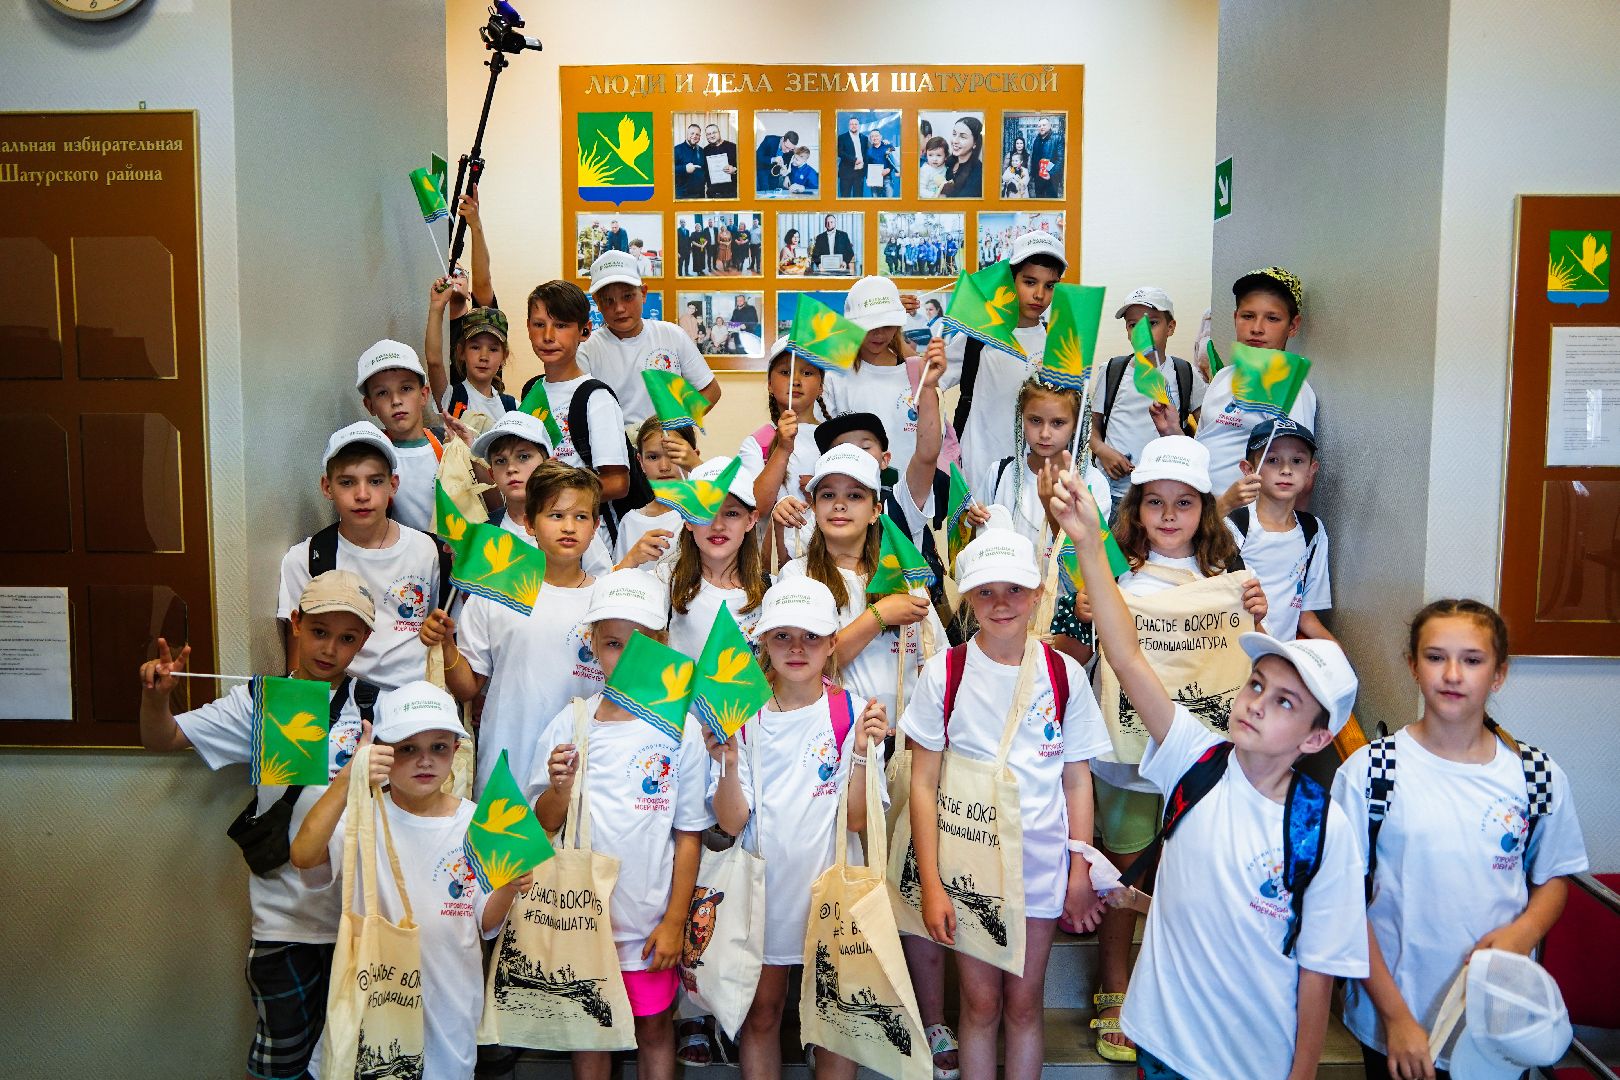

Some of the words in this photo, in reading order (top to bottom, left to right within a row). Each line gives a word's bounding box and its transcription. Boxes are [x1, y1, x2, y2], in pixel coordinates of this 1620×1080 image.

[585, 73, 665, 97] ЛЮДИ
[675, 73, 694, 94] И
[703, 73, 773, 97] ДЕЛА
[785, 72, 880, 93] ЗЕМЛИ
[891, 65, 1058, 93] ШАТУРСКОЙ
[0, 141, 56, 153] альная
[64, 136, 183, 156] избирательная
[0, 163, 98, 186] Шатурского
[106, 162, 163, 185] района
[967, 802, 997, 824] ВОКР
